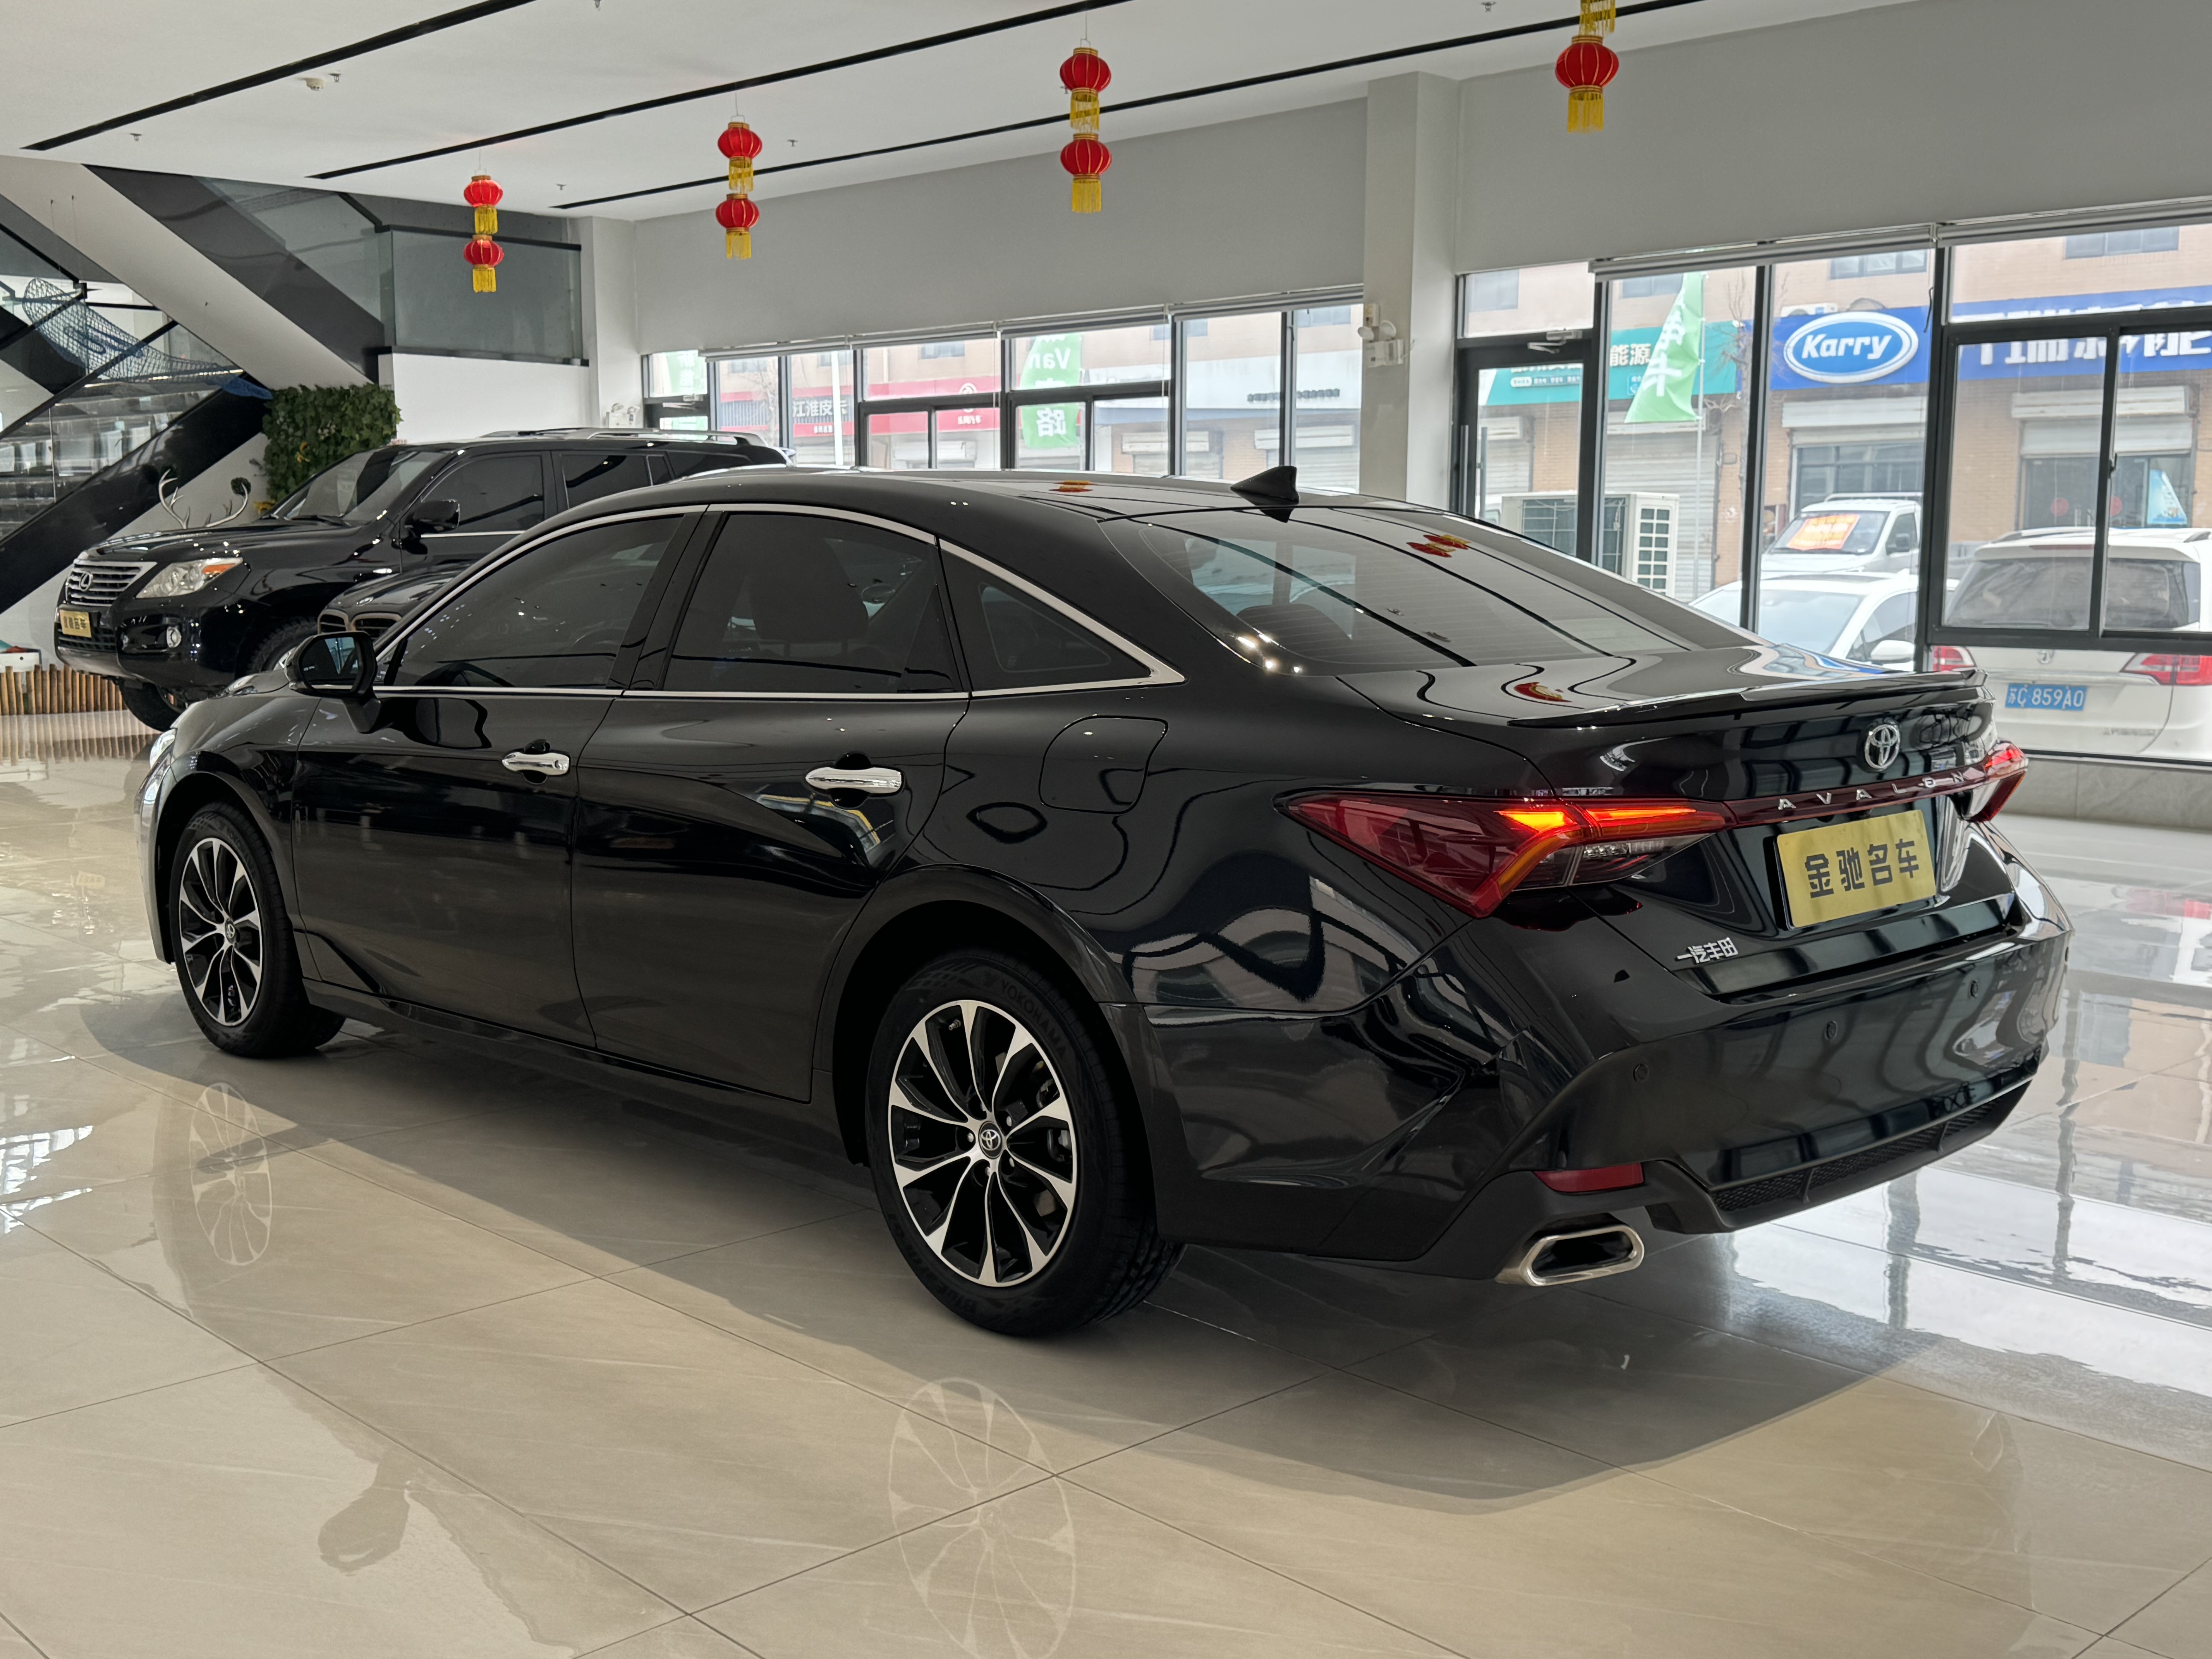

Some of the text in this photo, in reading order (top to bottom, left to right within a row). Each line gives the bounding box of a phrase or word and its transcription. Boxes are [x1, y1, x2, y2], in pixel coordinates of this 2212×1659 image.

[1611, 344, 1651, 366] 能源
[1802, 333, 1892, 360] Karry
[1778, 771, 1964, 810] AVALON
[1805, 838, 1919, 898] 金驰名车
[1677, 937, 1738, 963] 一汽丰田
[1001, 979, 1066, 1057] YOKOHAMA
